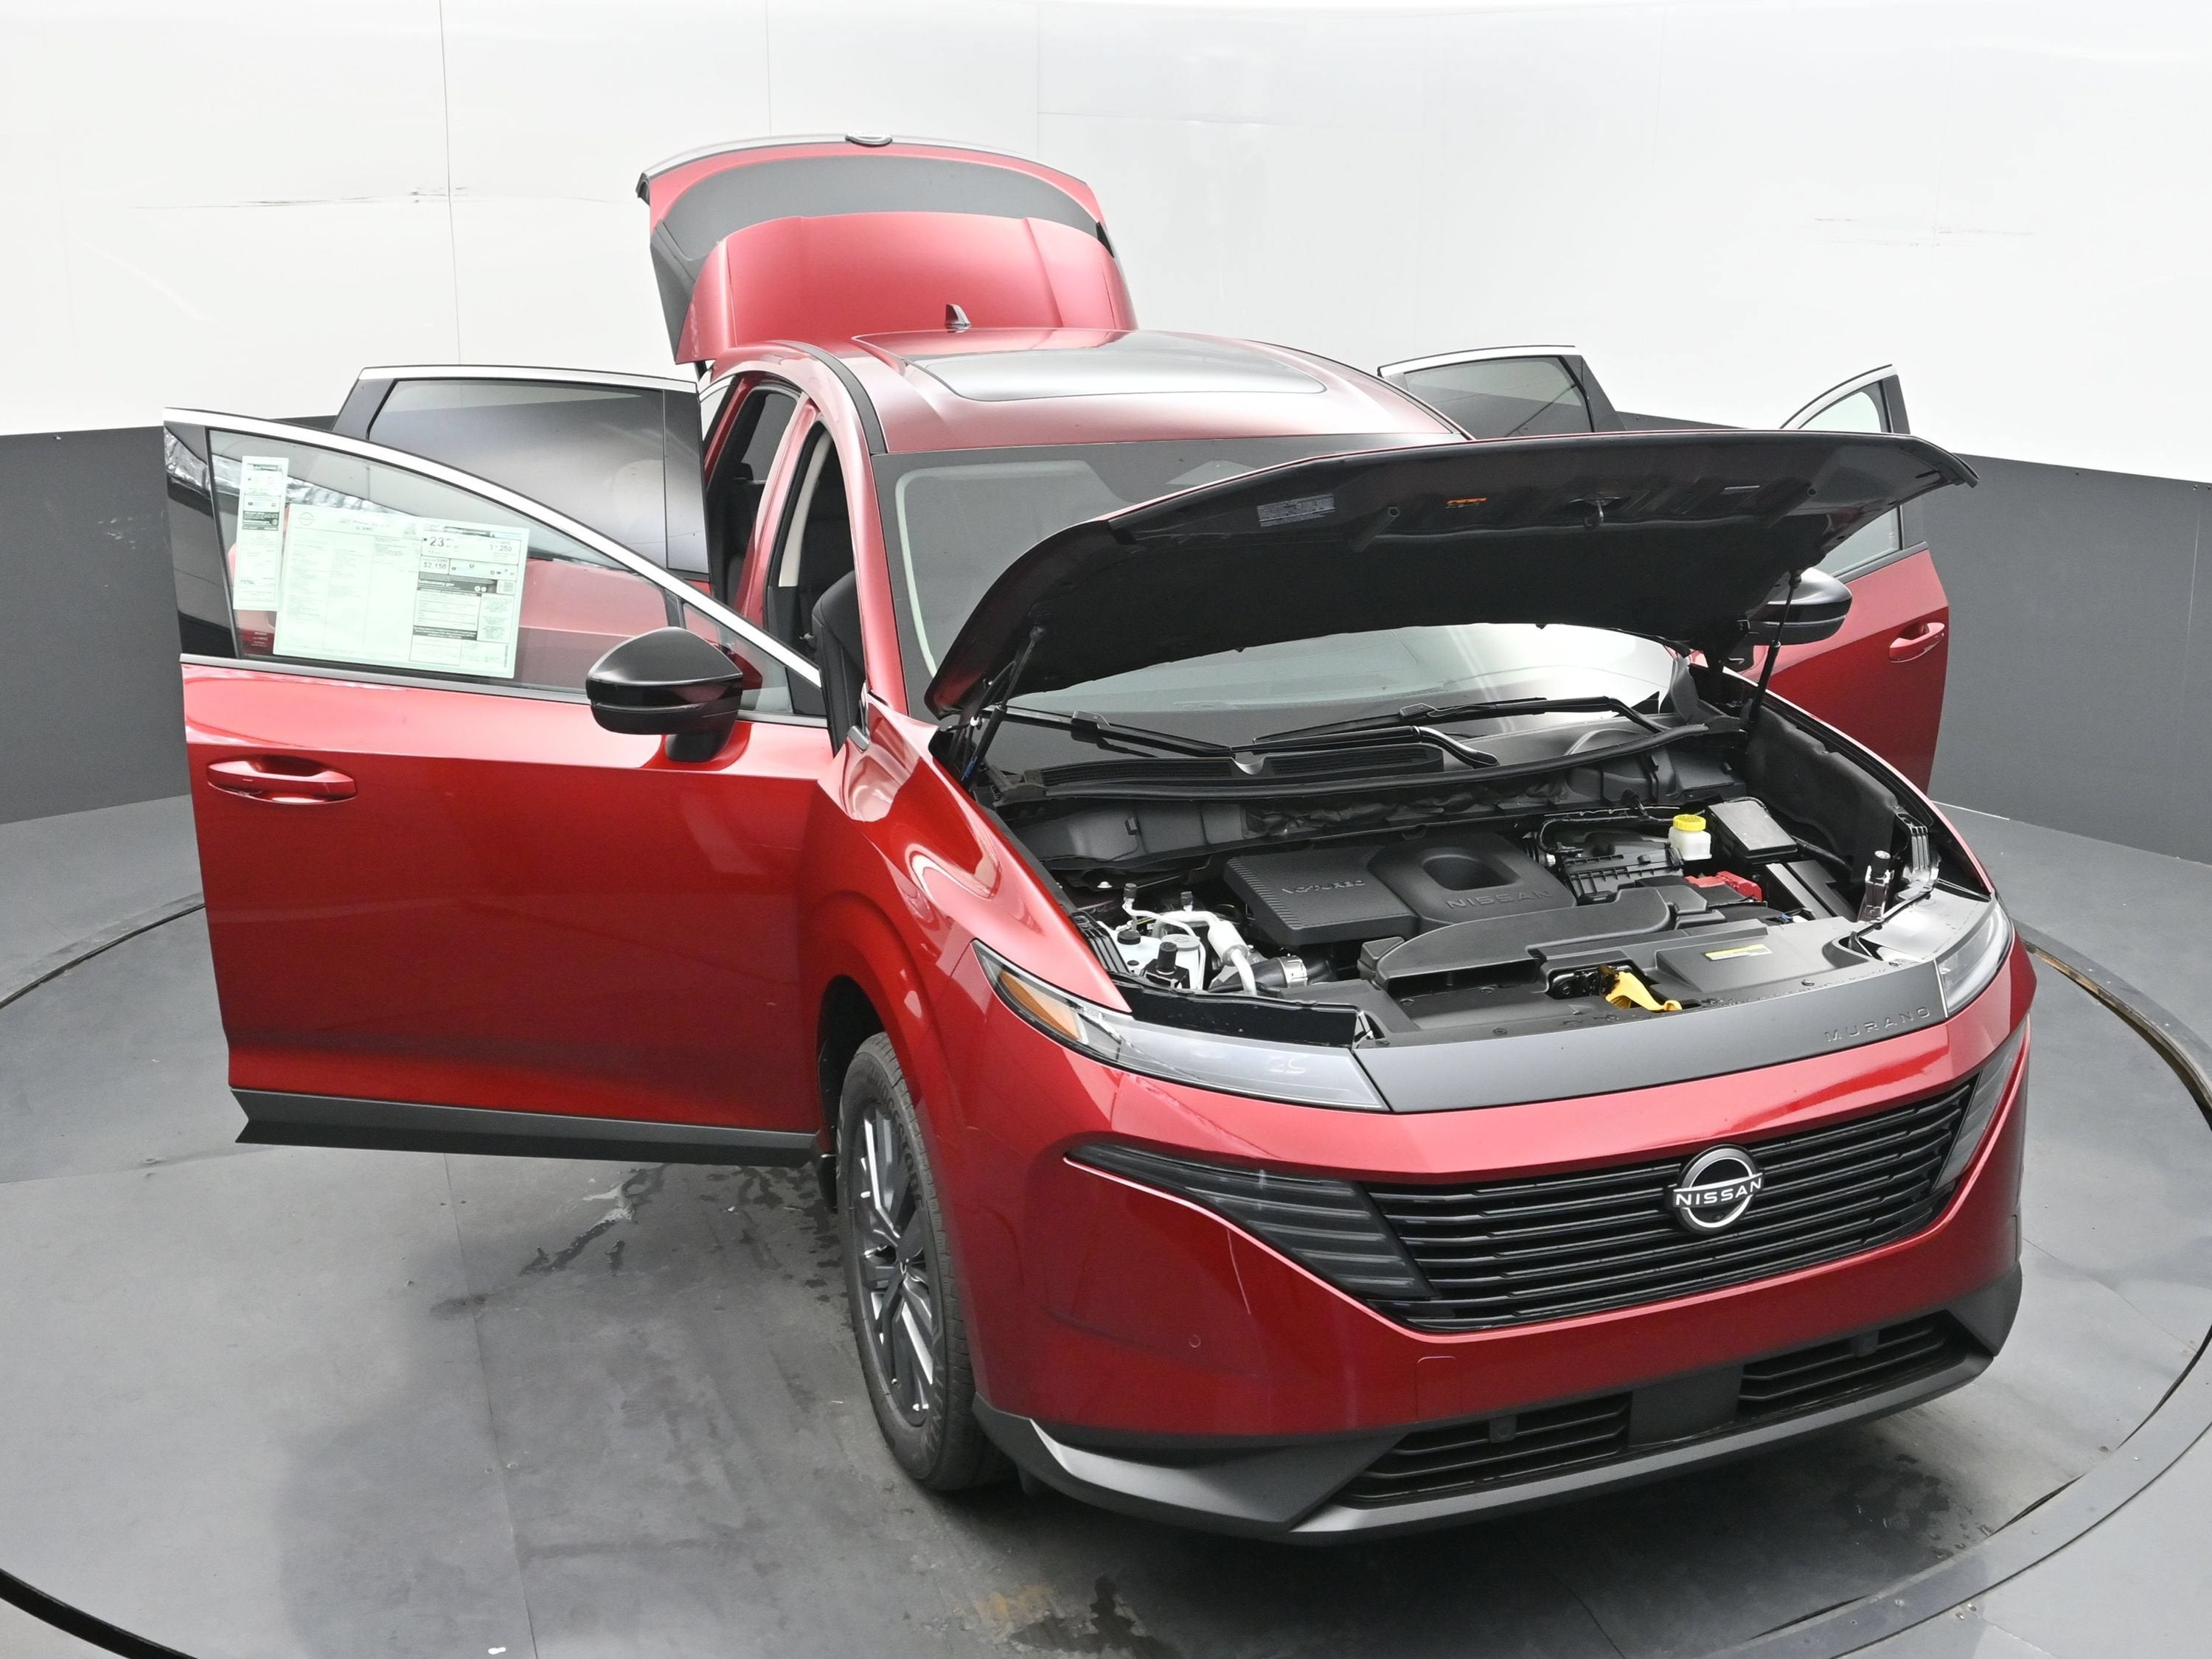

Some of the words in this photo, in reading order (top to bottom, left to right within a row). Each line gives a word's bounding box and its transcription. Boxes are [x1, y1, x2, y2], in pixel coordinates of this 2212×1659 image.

[429, 536, 445, 547] 23
[1445, 890, 1554, 909] NISSAN
[1824, 1006, 1930, 1042] MURANO
[1675, 1178, 1762, 1206] NISSAN
